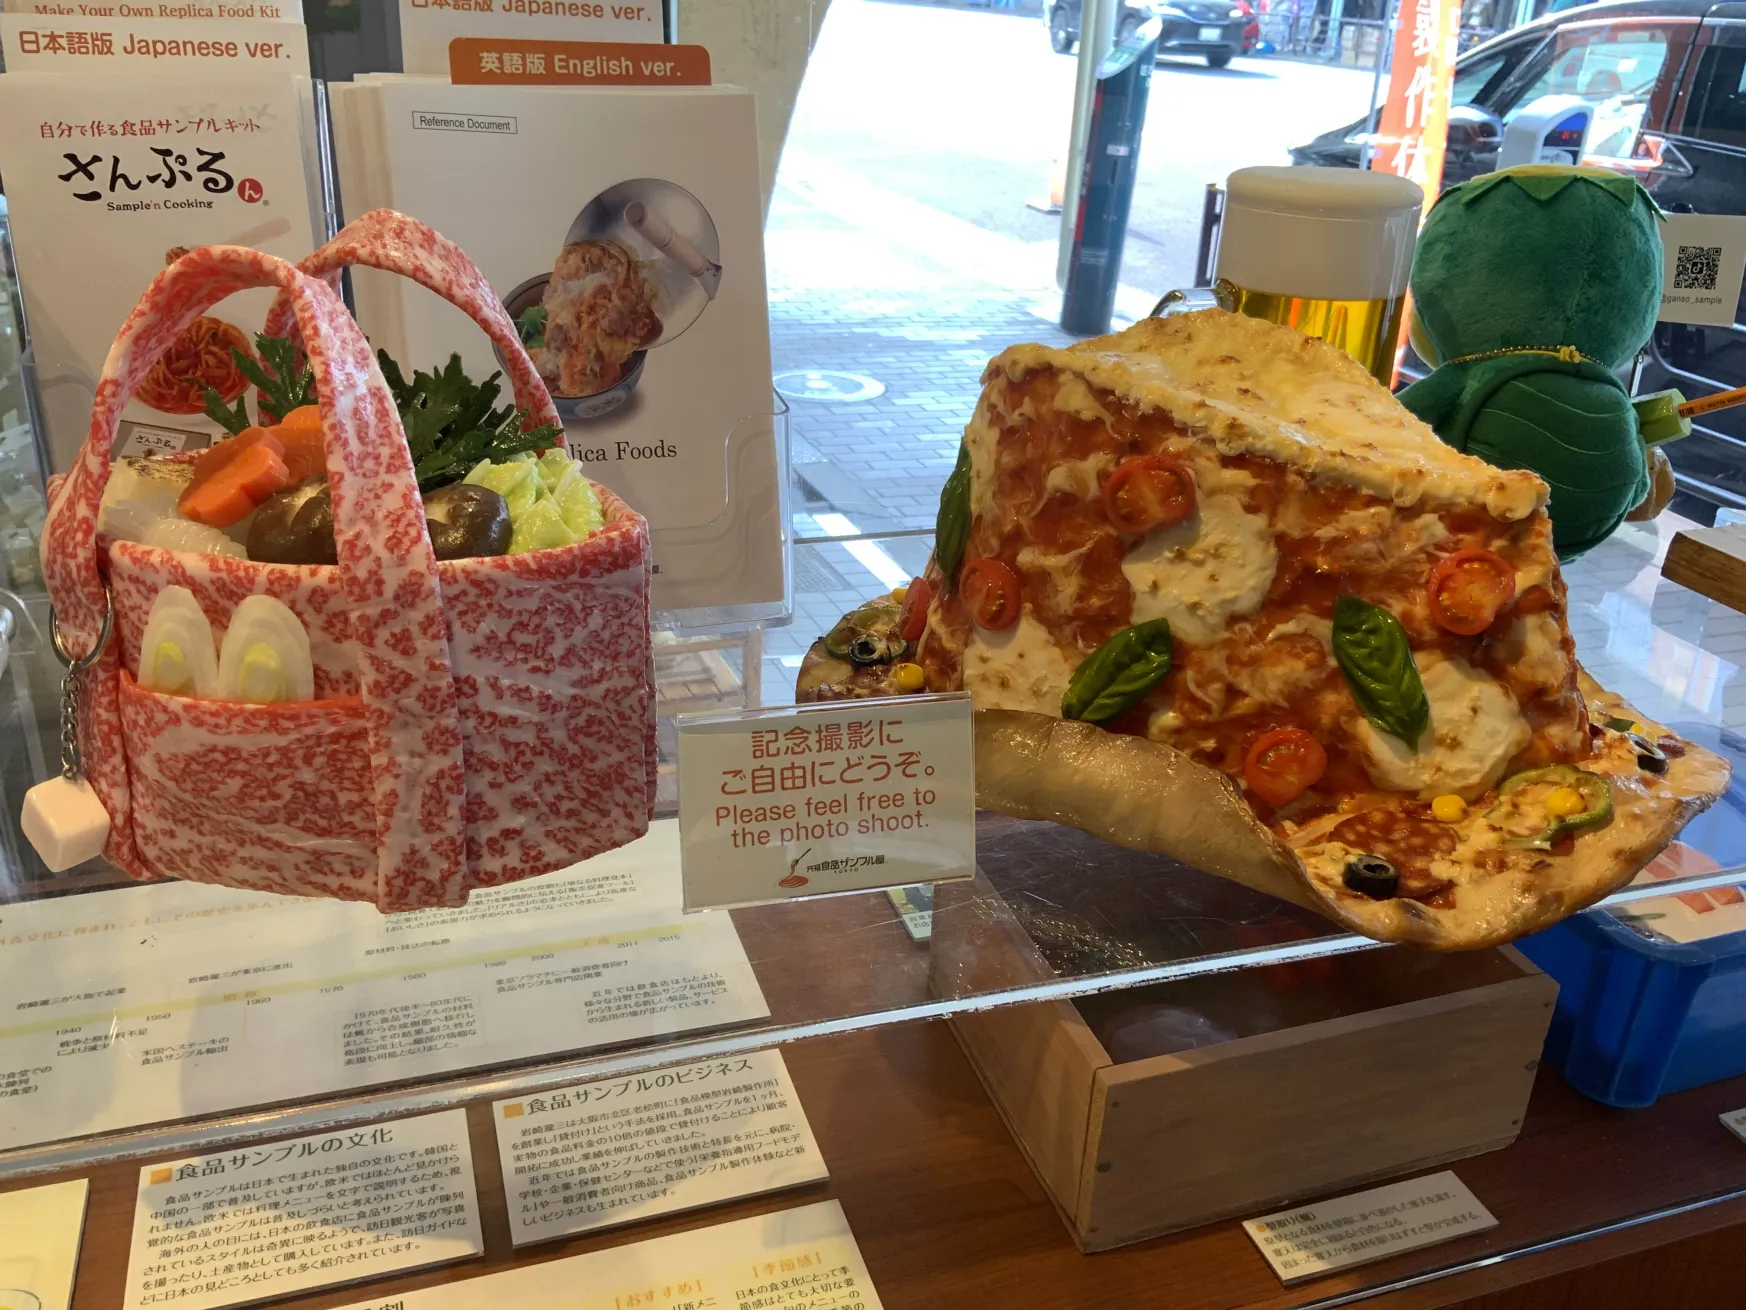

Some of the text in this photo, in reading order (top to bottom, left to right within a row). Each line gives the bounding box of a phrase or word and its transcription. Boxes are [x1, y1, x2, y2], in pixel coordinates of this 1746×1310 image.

[34, 4, 281, 19] Make Your Own Replica Food Kit
[502, 0, 604, 18] Japanese
[611, 5, 652, 22] ver.
[19, 31, 292, 59] 日本語版 Japanese ver.
[479, 52, 682, 77] 英語版 English ver.
[40, 117, 261, 139] 自分で作る食品サンプルキット
[420, 115, 511, 132] Reference Document
[58, 147, 235, 202] さんぷる
[163, 199, 214, 210] Cooking
[568, 439, 677, 462] lica Foods
[751, 719, 904, 759] 記念撮影に
[720, 750, 935, 796] ご自由にどうぞ。
[715, 787, 936, 827] Please feel free to
[731, 809, 929, 849] the photo shoot.
[527, 1058, 754, 1116] 食品サンプルのビジネス
[175, 1126, 394, 1182] 食品サンプルの文化
[735, 1265, 850, 1300] 日本の食文化にとって季
